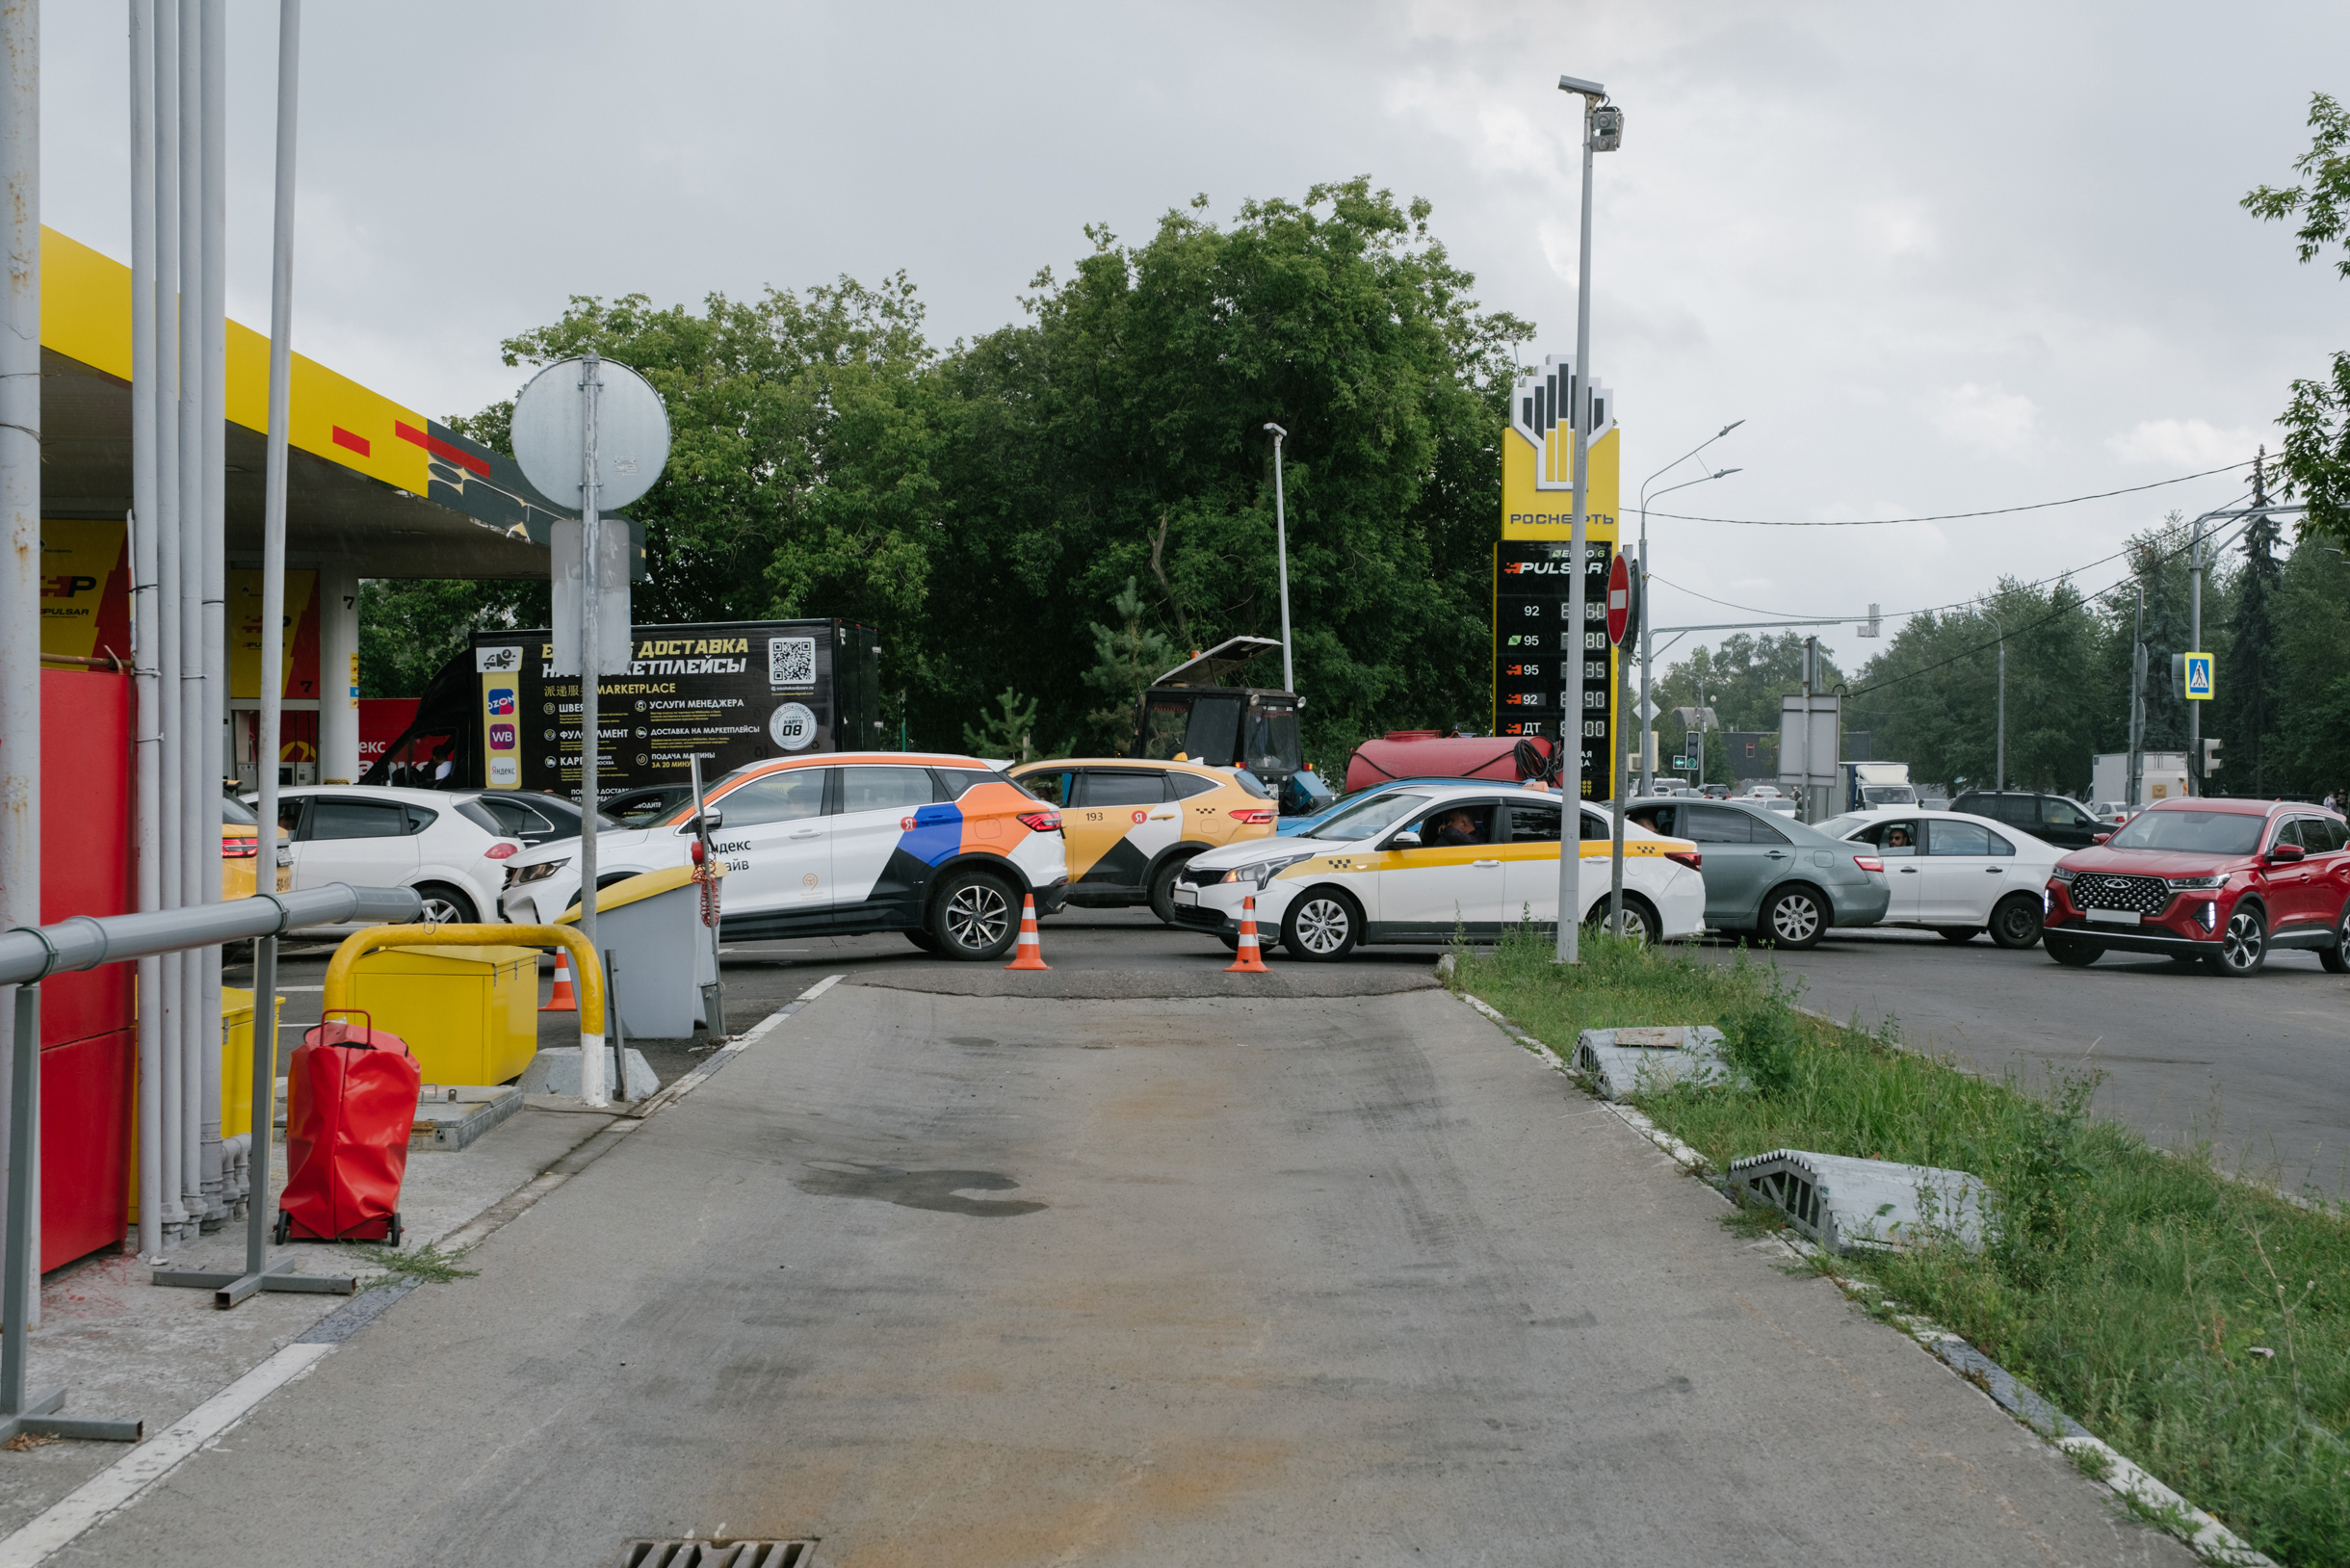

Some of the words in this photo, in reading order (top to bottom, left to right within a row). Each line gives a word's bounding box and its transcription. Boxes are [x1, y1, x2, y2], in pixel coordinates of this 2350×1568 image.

[1510, 513, 1614, 525] РОСНЕТЬ
[1520, 562, 1604, 574] PULSR
[343, 596, 355, 610] 7
[1524, 606, 1540, 616] 92
[1524, 636, 1540, 646] 95
[638, 639, 749, 659] ДОСТАВКА
[1524, 665, 1540, 675] 95
[300, 681, 313, 693] 7
[544, 685, 583, 696] 派递服
[488, 694, 515, 710] OZON
[649, 700, 686, 710] УСЛУГИ
[688, 699, 744, 709] МЕНЕДЖЕРА
[1523, 694, 1538, 705] 92
[560, 729, 628, 740] ФУЛЛМЕНТ
[703, 724, 761, 735] МАРКЕТПЛЕЙСЫ
[782, 725, 803, 737] 08
[1523, 722, 1542, 736] ДТ
[492, 731, 512, 742] WB
[359, 741, 386, 754] екс
[560, 756, 584, 767] КАРГ
[491, 766, 515, 775] Яндекс
[1085, 812, 1104, 822] 193
[1134, 812, 1144, 823] Я
[903, 819, 914, 829] Я
[714, 840, 751, 854] ндекс
[724, 858, 749, 872] айв
